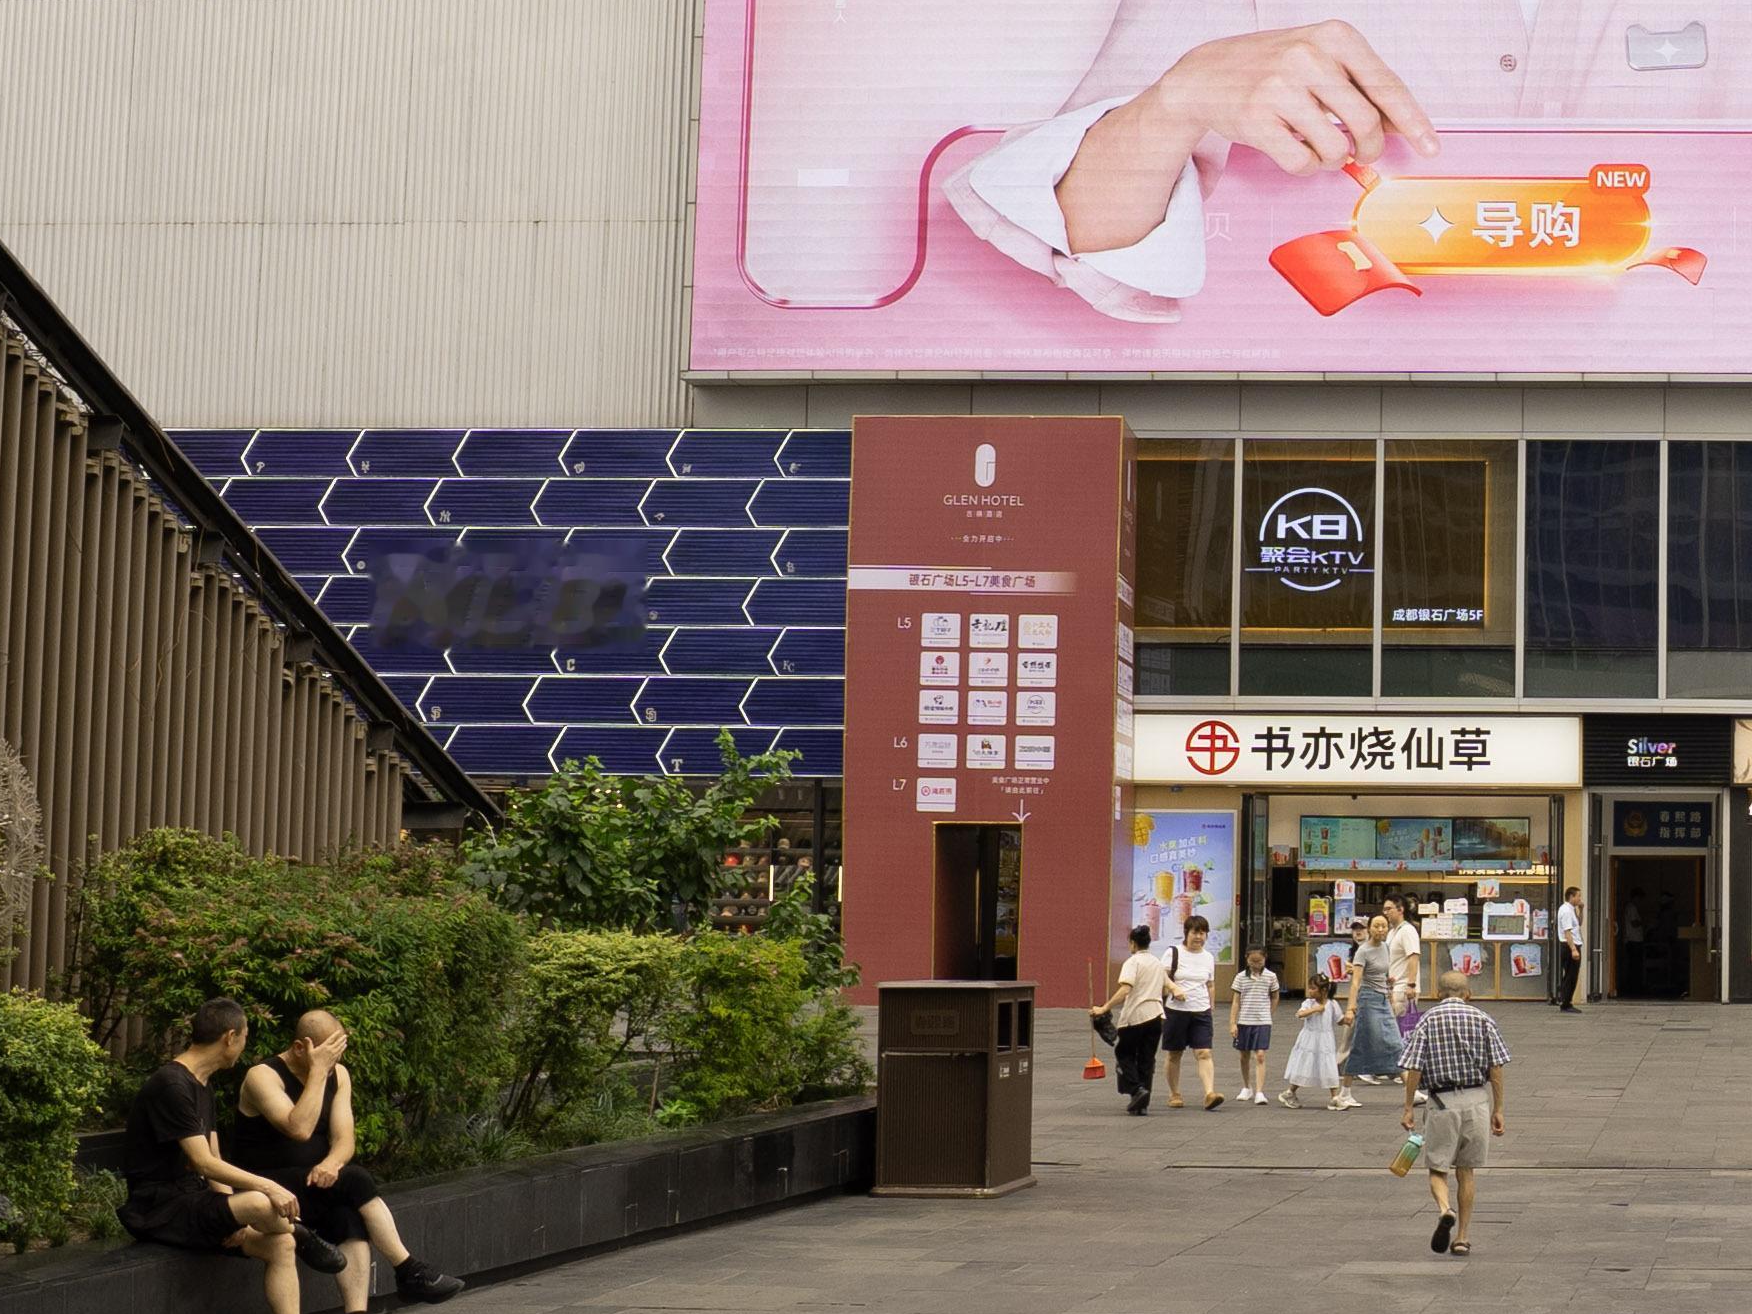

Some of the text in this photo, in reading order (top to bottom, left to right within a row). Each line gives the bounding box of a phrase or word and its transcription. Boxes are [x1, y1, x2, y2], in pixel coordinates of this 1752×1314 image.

[1596, 170, 1646, 189] NEW
[1471, 200, 1581, 249] 导购
[943, 494, 1024, 506] GLEN HOTEL
[1260, 546, 1365, 565] 聚会KTV
[1274, 566, 1349, 575] PARTY KTV
[1392, 608, 1484, 621] 成都银石广场5F
[897, 617, 912, 629] L5
[893, 736, 908, 748] L6
[1250, 725, 1492, 772] 书亦烧仙草
[1627, 737, 1676, 755] Silver
[1627, 756, 1678, 768] 银石广场
[892, 778, 908, 791] L7
